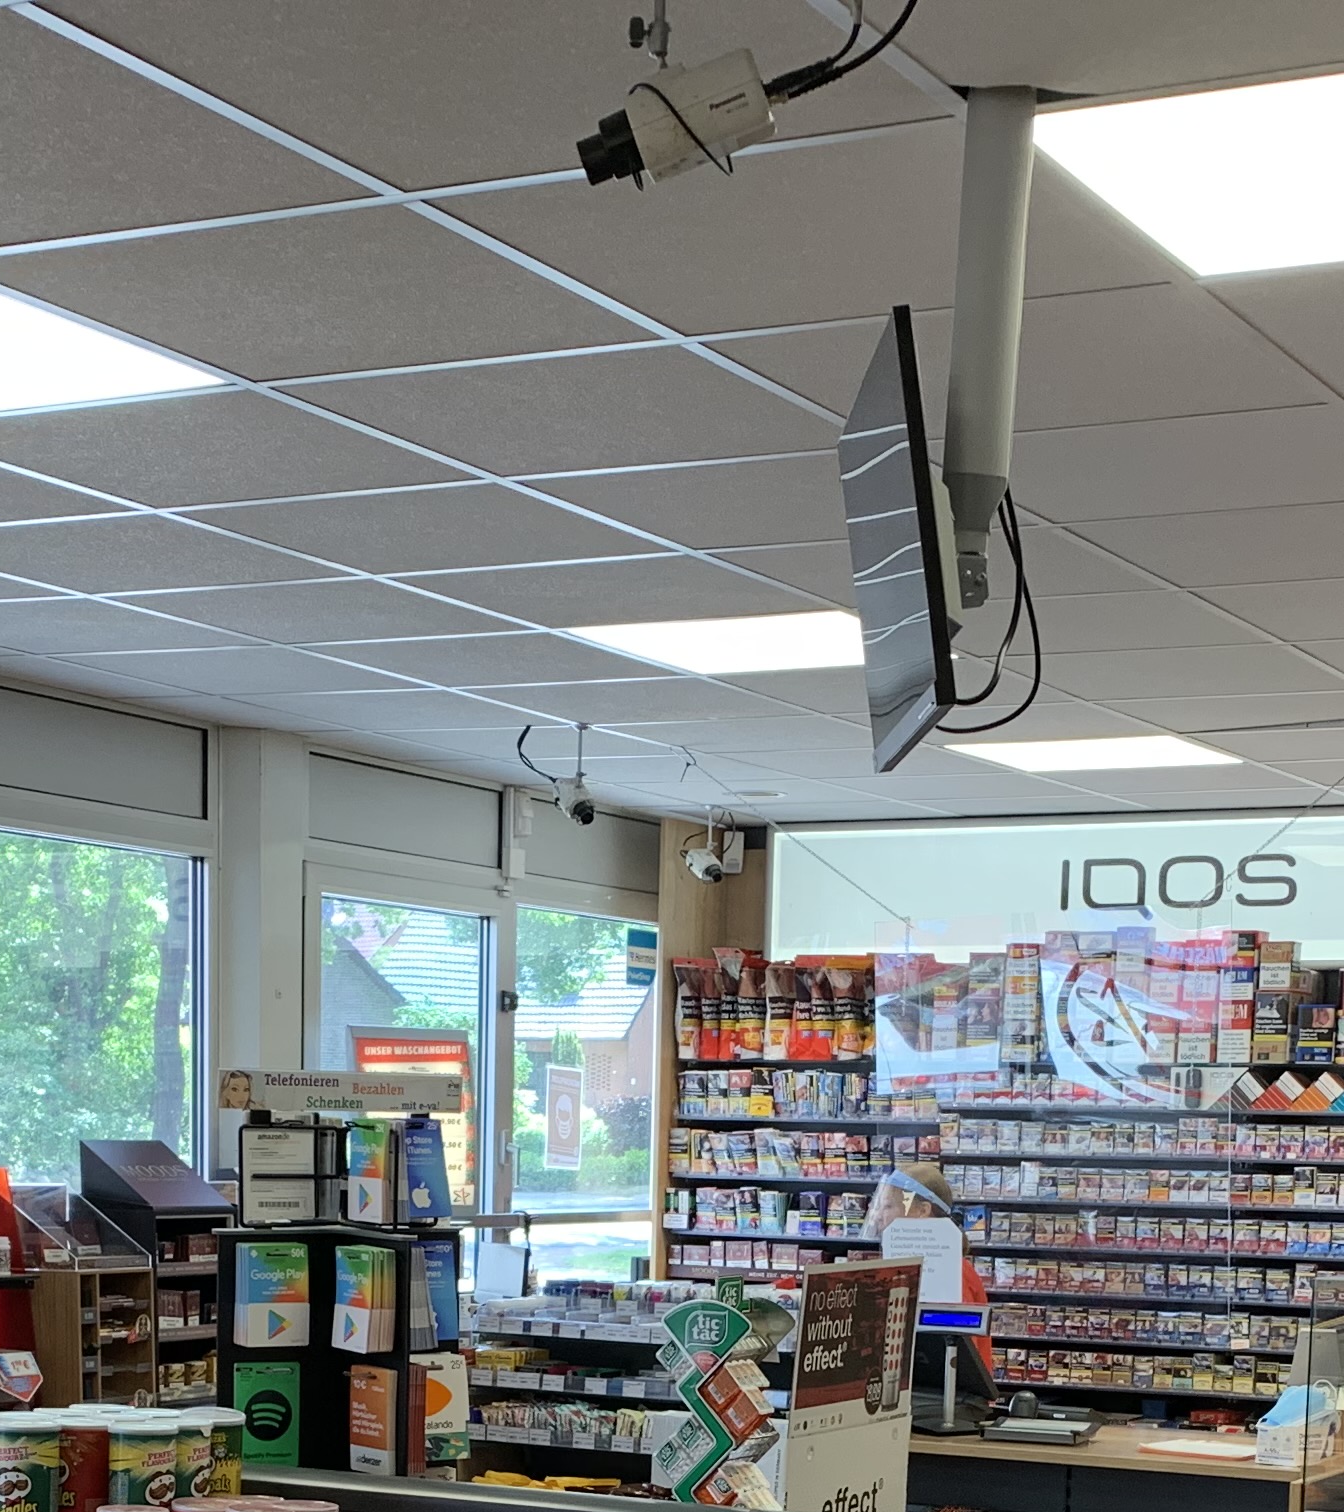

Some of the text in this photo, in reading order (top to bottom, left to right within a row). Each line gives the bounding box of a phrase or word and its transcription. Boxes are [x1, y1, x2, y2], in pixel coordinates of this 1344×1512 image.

[1060, 854, 1298, 920] IQOS
[1263, 978, 1286, 986] tödlich
[364, 1045, 462, 1055] UNSER WASCHANGEBOT
[264, 1074, 339, 1088] Telefonieren
[352, 1083, 404, 1096] Bezahlen
[306, 1096, 363, 1109] Schenken
[401, 1102, 417, 1110] mit
[412, 1136, 432, 1145] Store
[250, 1269, 306, 1282] Google Play
[337, 1269, 356, 1283] Google
[725, 1286, 738, 1297] tic
[809, 1286, 858, 1312] no effect
[696, 1316, 721, 1328] tic
[807, 1316, 852, 1341] without
[692, 1327, 720, 1341] tac
